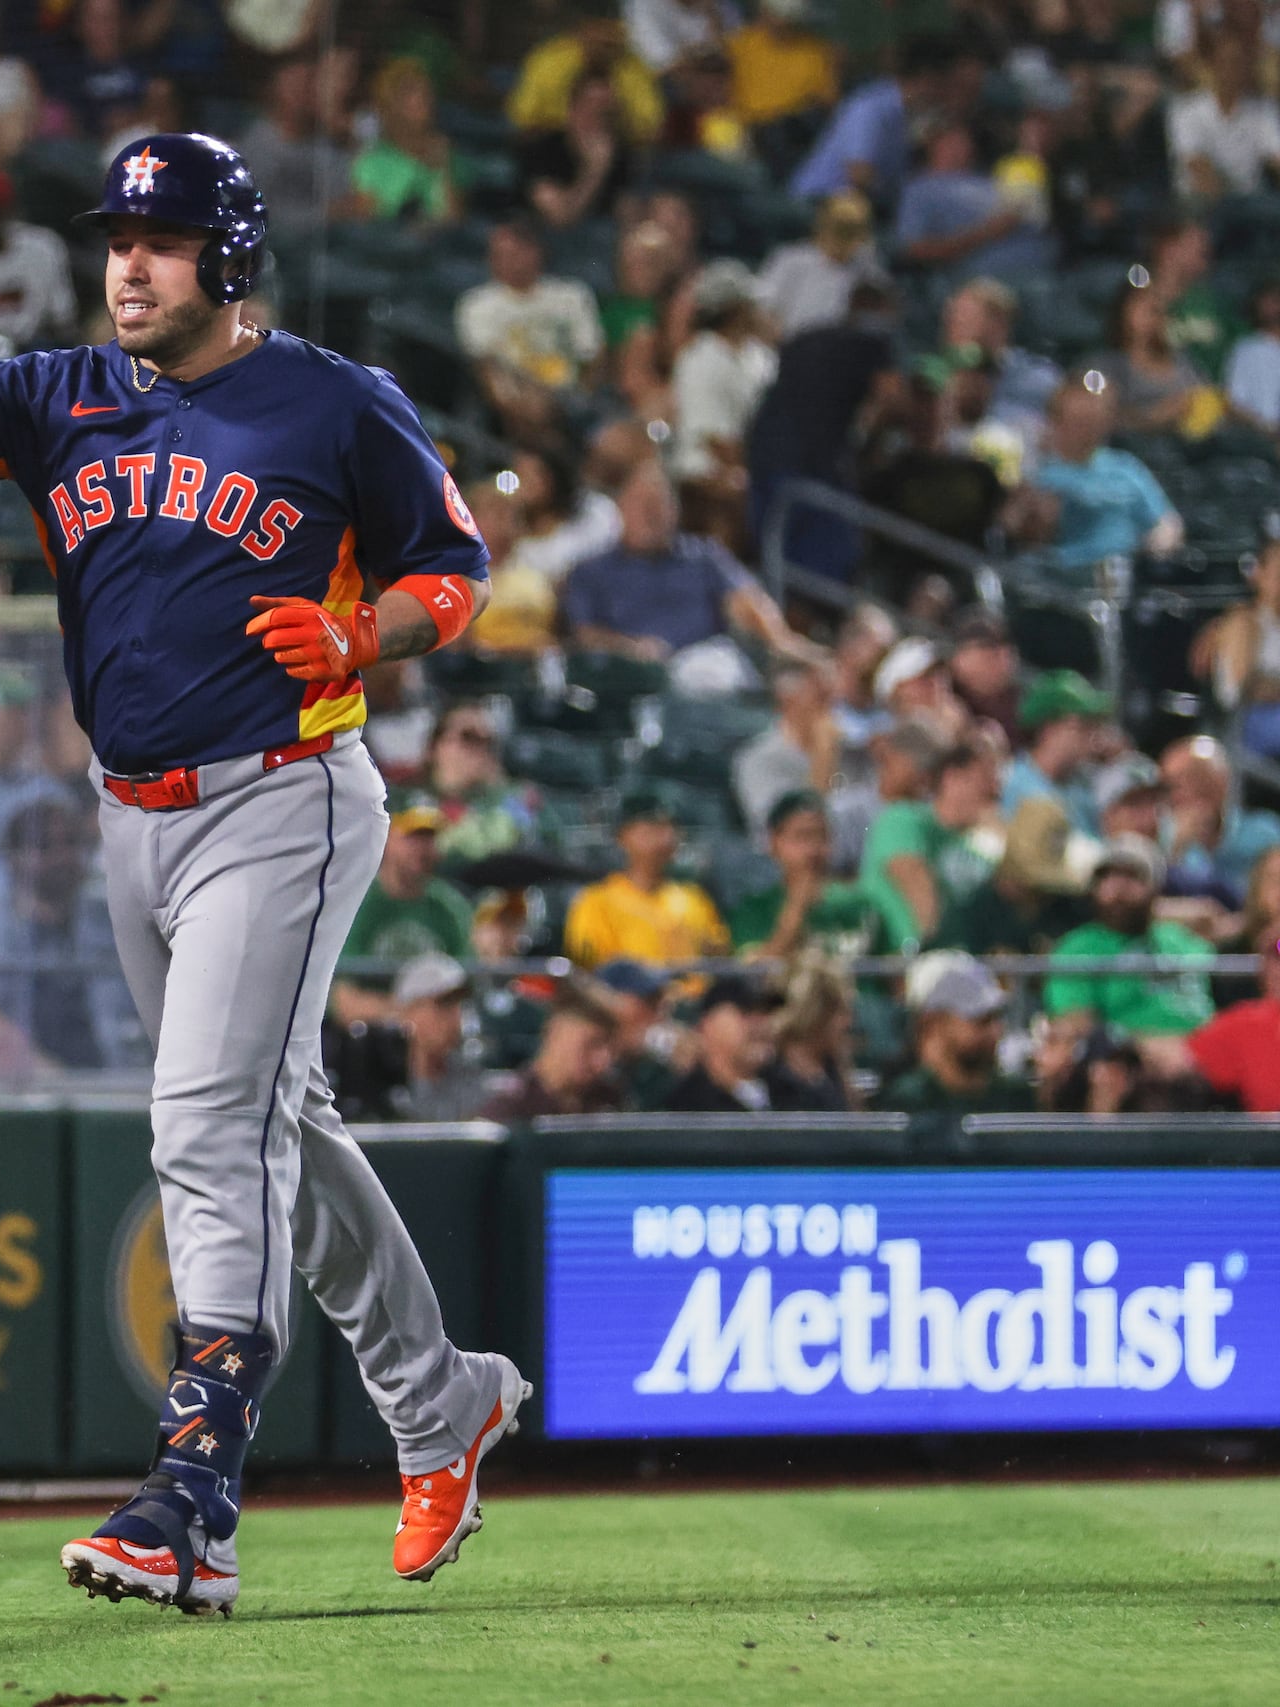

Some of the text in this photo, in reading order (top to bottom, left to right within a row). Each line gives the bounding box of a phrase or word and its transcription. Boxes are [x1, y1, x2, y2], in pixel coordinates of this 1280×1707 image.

[48, 452, 304, 562] ASTROS
[433, 591, 453, 609] 17
[632, 1203, 878, 1259] HOUSTON
[632, 1238, 1238, 1396] Methodist
